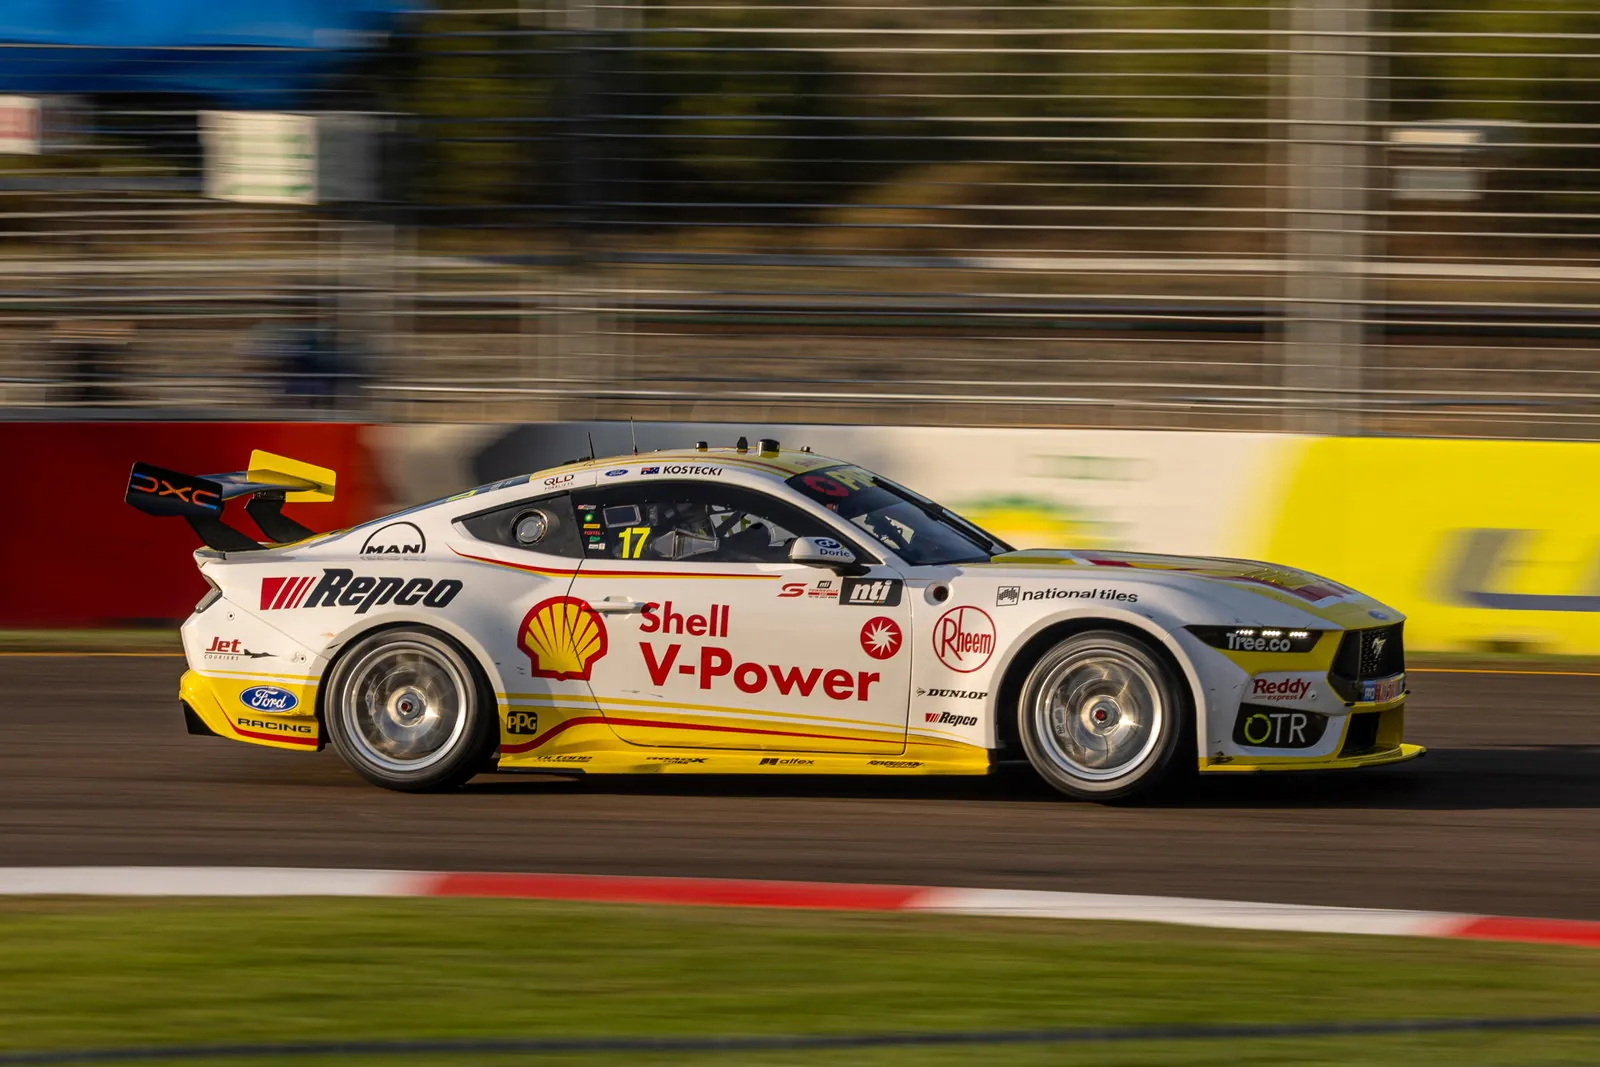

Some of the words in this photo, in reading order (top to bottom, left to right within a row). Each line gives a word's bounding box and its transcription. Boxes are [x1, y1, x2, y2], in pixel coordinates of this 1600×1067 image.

[543, 474, 575, 486] QLD
[663, 465, 723, 477] KOSTECKI
[130, 472, 220, 511] DXC
[365, 544, 421, 555] MAN
[618, 527, 651, 559] 17
[820, 548, 851, 558] Doric
[303, 568, 464, 615] Repco
[850, 580, 893, 601] nti
[1022, 588, 1097, 602] national
[1099, 589, 1139, 603] tiles
[639, 601, 730, 638] Shell
[205, 636, 242, 653] Jet
[940, 608, 992, 661] Rheem
[1226, 632, 1291, 652] Tree.co
[639, 641, 881, 702] V-Power
[926, 688, 988, 700] DUNLOP
[1252, 678, 1311, 700] Reddy
[250, 689, 287, 710] Ford
[237, 717, 312, 734] RACING
[507, 712, 537, 733] PPG
[938, 711, 978, 727] Repco
[1244, 713, 1308, 744] OTR
[779, 757, 815, 765] alfex
